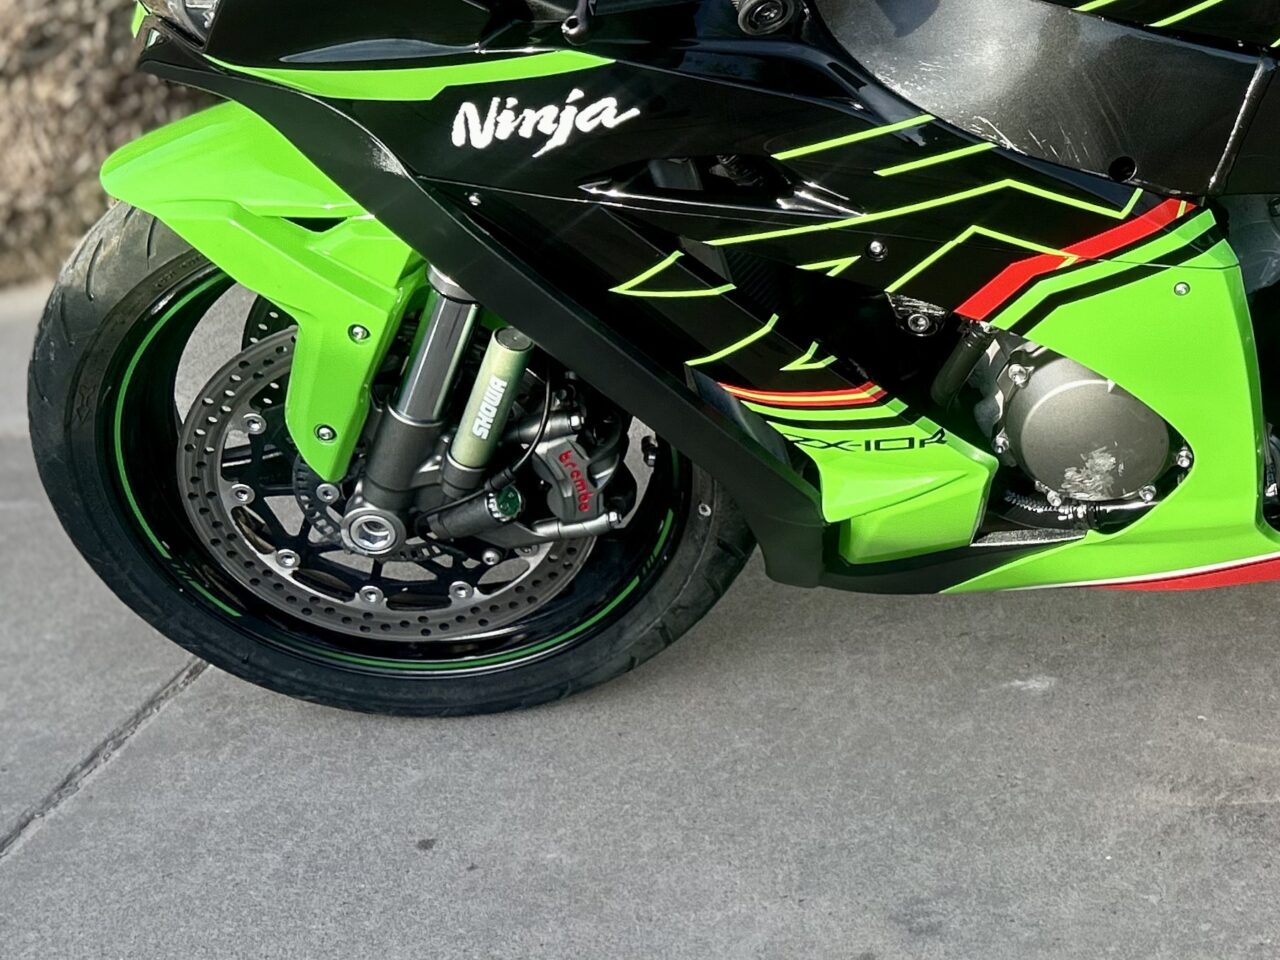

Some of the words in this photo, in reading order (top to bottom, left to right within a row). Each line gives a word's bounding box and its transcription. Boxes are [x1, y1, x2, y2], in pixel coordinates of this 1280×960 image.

[451, 88, 641, 158] Ninja
[472, 374, 508, 440] SHOWA
[559, 449, 594, 513] brembo
